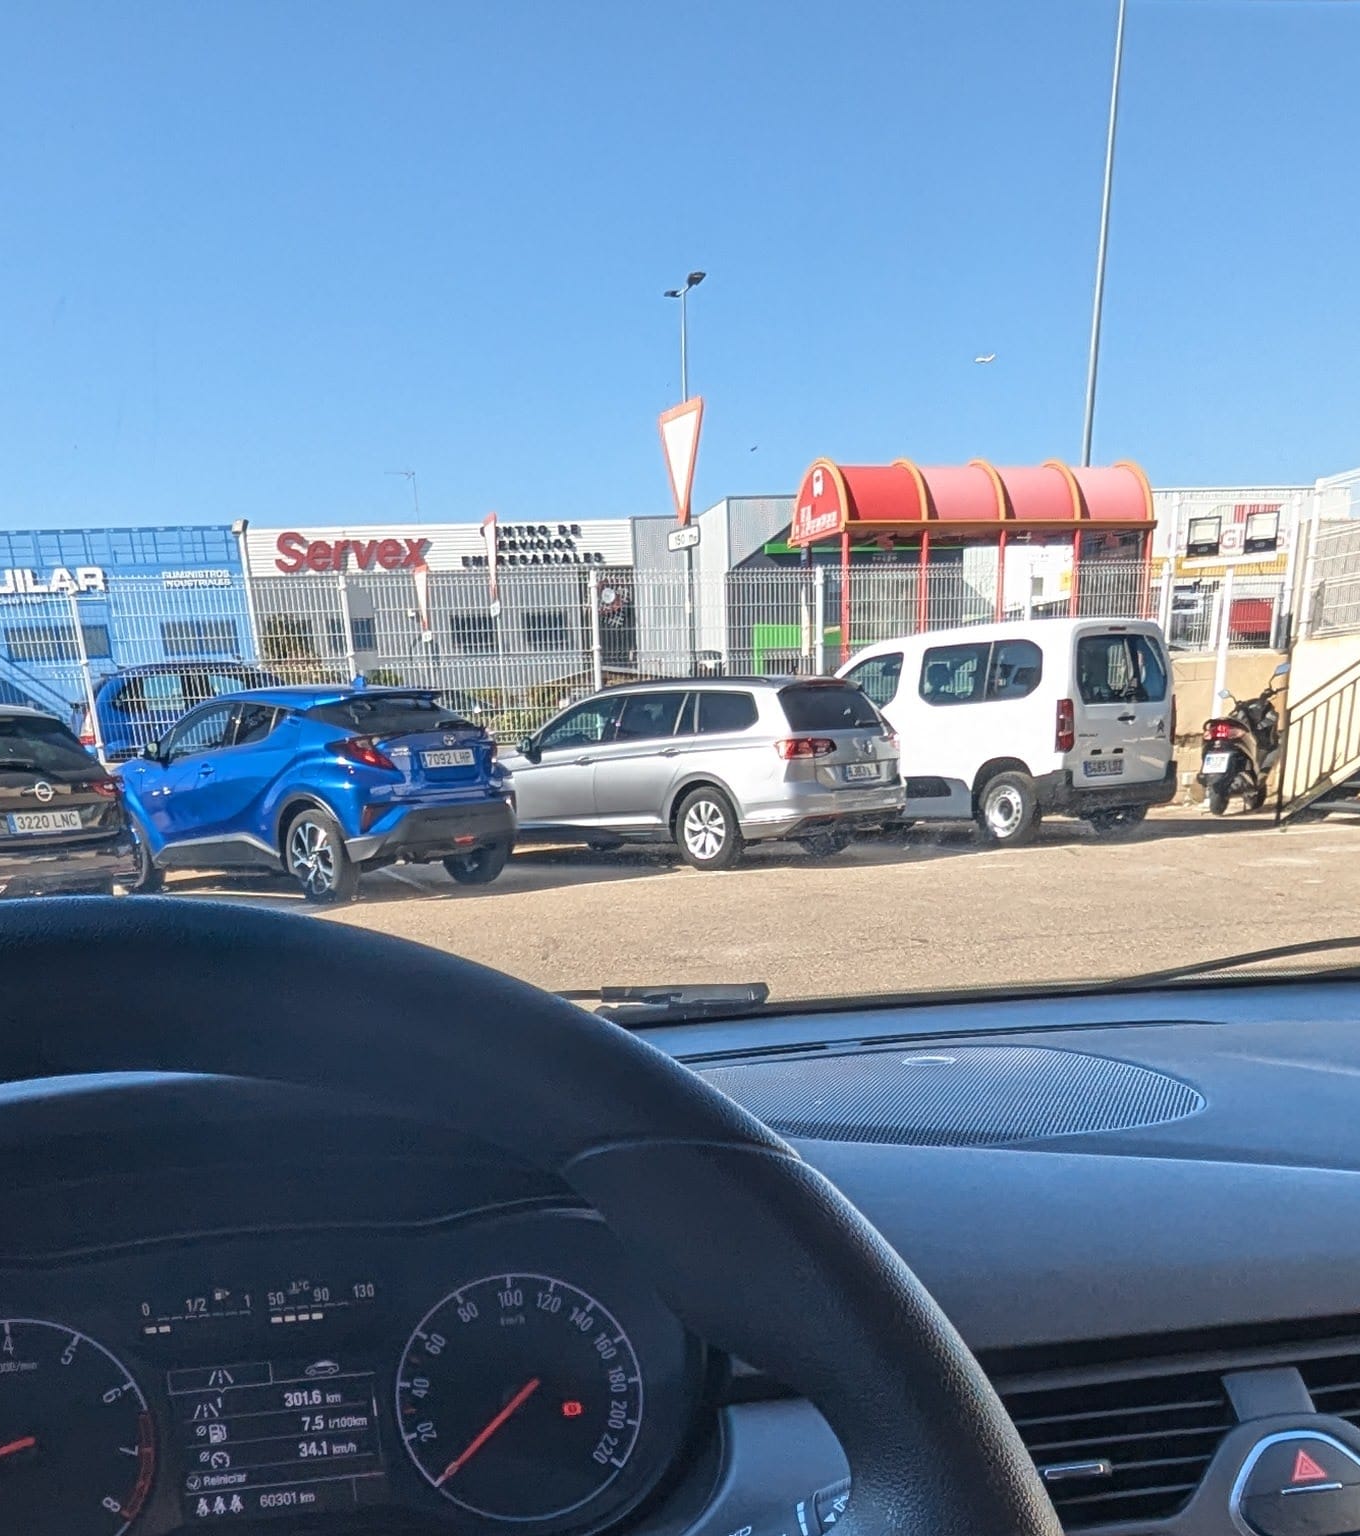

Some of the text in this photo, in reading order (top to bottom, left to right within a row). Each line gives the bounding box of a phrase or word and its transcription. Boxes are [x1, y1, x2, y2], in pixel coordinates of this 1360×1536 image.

[558, 524, 580, 536] DE
[275, 531, 430, 573] Servex
[498, 538, 575, 551] ERVICIOS
[426, 753, 451, 766] 7092
[17, 813, 78, 830] 3220 LNC
[268, 1283, 375, 1306] 50 90 130
[497, 1289, 523, 1308] 100
[536, 1291, 562, 1313] 120
[186, 1298, 207, 1312] 1/2
[456, 1302, 479, 1323] 80
[569, 1307, 594, 1332] 140
[3, 1336, 15, 1355] 4
[425, 1334, 446, 1355] 60
[593, 1333, 617, 1360] 160
[60, 1346, 76, 1366] 5
[411, 1377, 430, 1399] 40
[608, 1366, 627, 1394] 180
[102, 1387, 122, 1404] 6
[284, 1390, 322, 1408] 301.6
[326, 1392, 342, 1404] km
[301, 1415, 325, 1432] 7.5
[608, 1400, 628, 1430] 200
[416, 1421, 437, 1442] 20
[118, 1445, 139, 1457] 7
[298, 1441, 357, 1457] 34.1 km/h
[593, 1433, 618, 1465] 220
[203, 1472, 247, 1487] Reiniciar
[101, 1496, 122, 1513] 8
[259, 1491, 316, 1508] 60301 km
